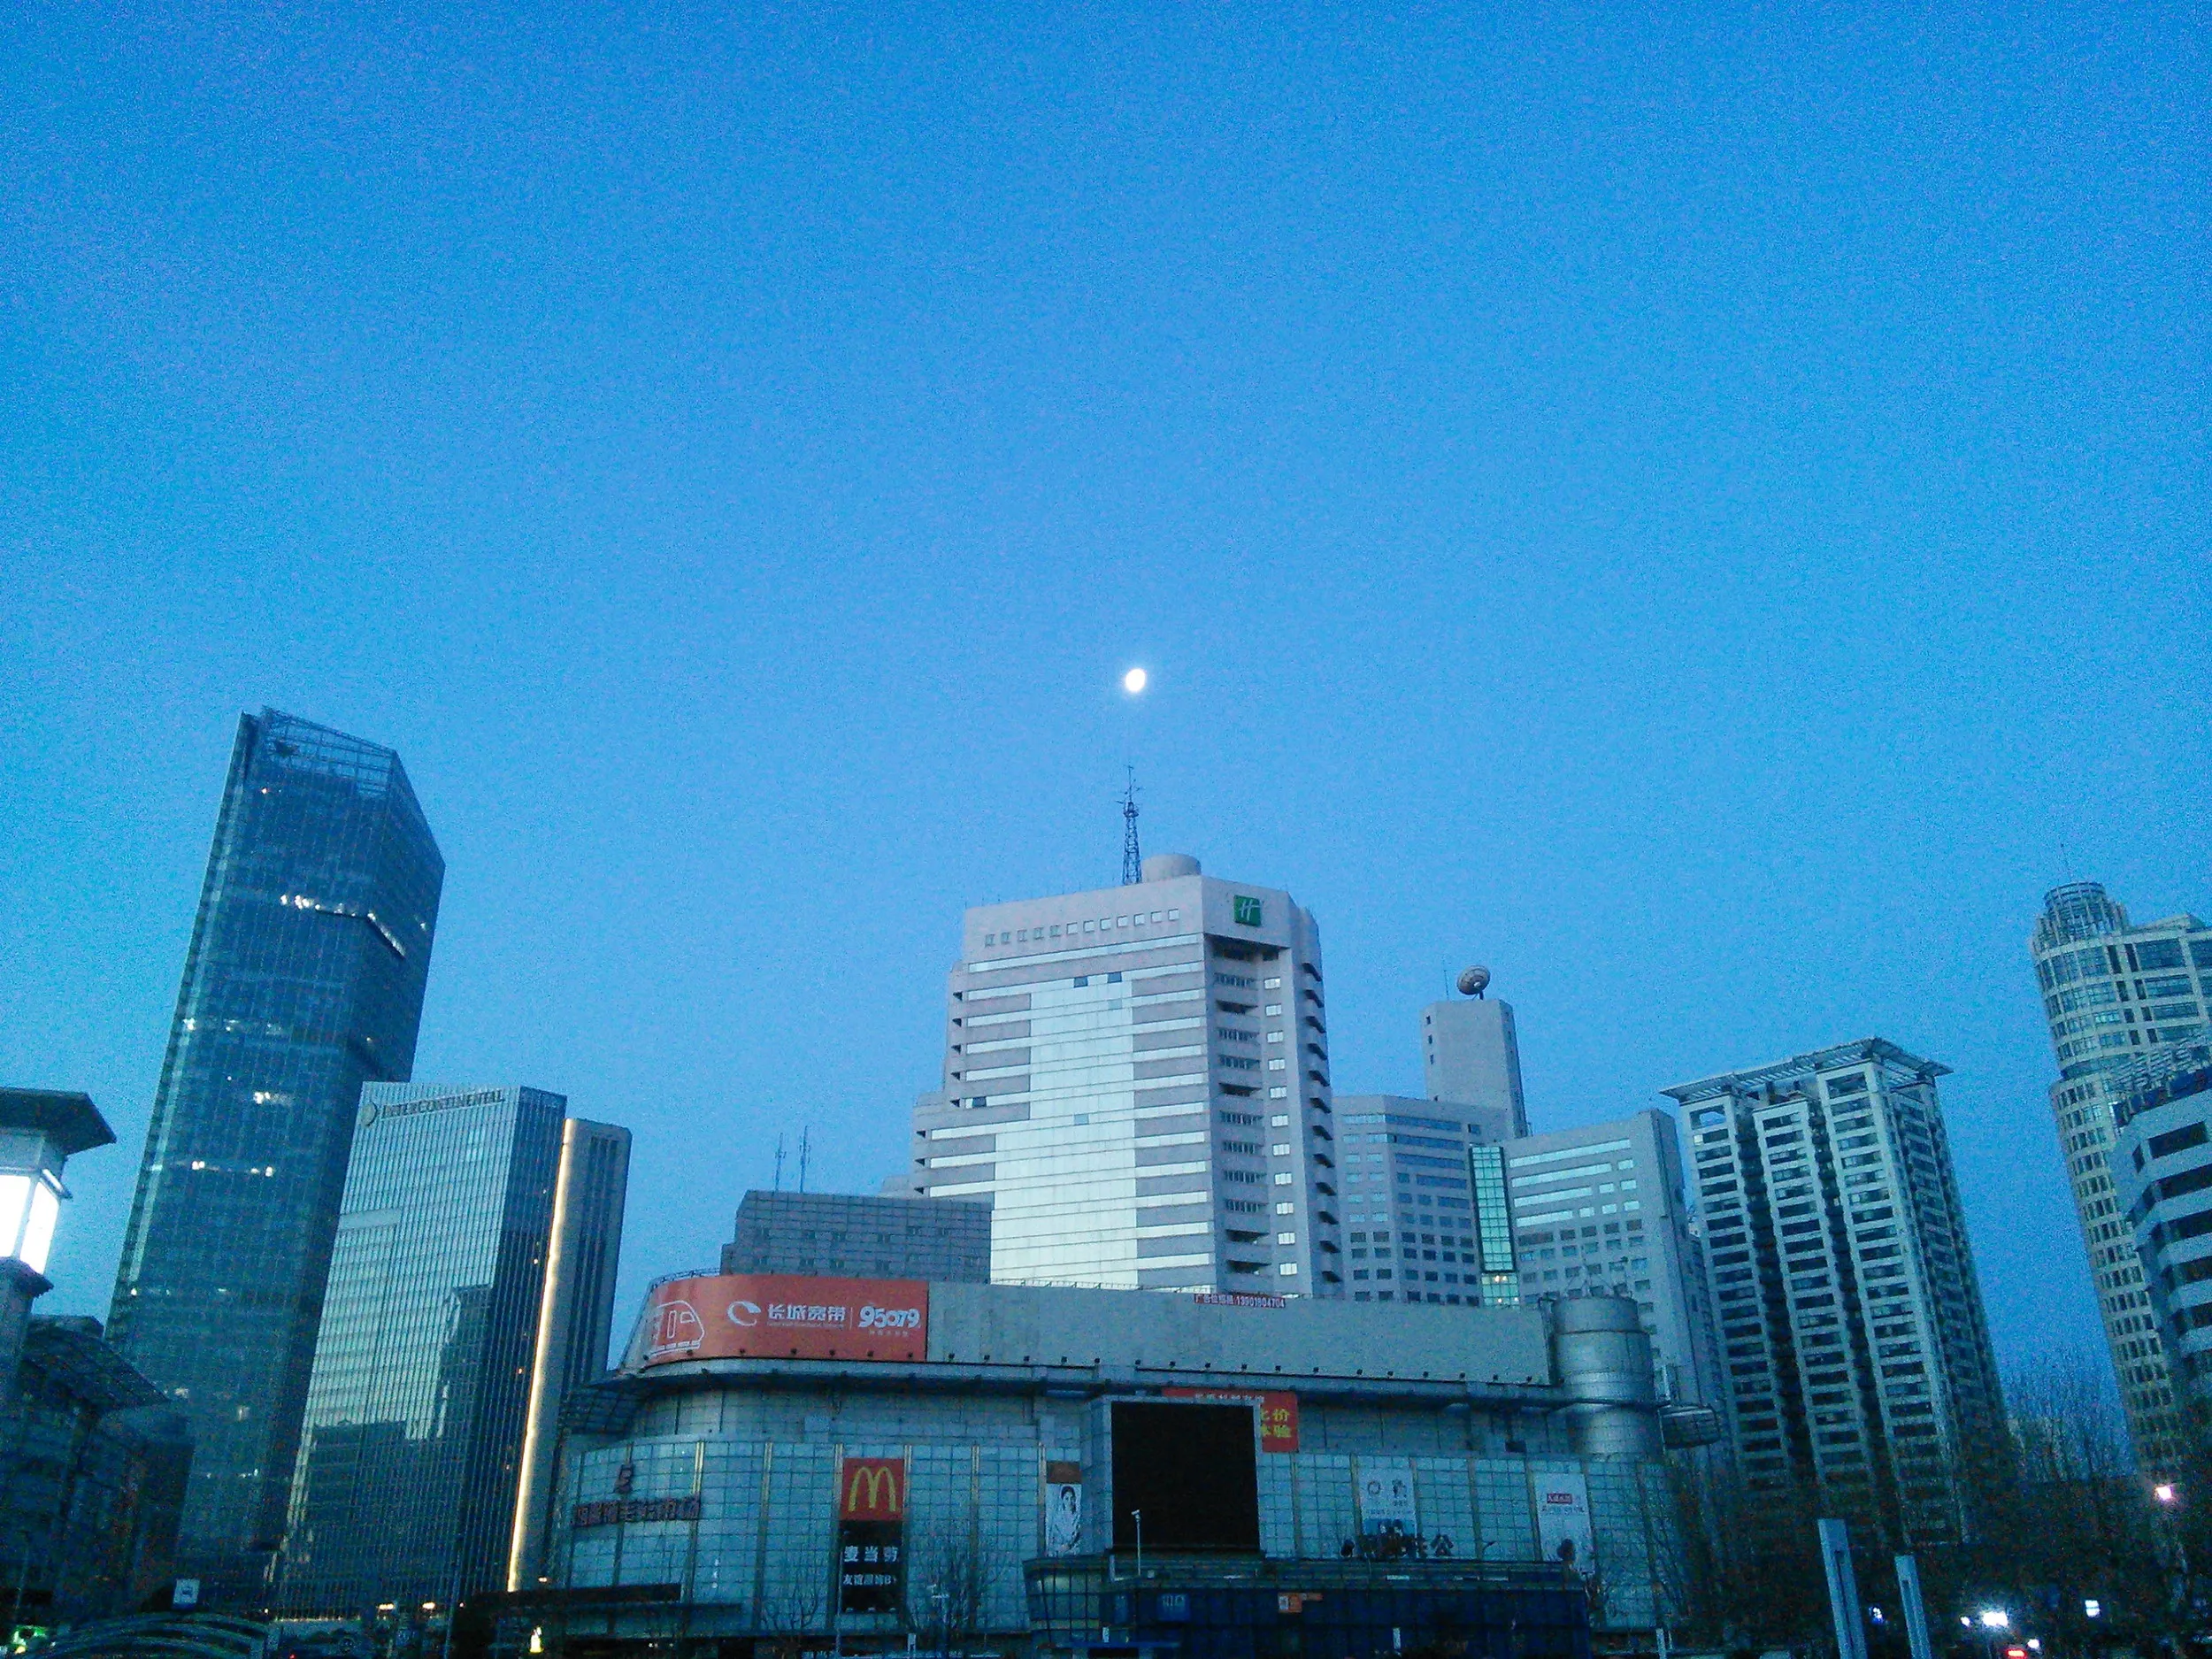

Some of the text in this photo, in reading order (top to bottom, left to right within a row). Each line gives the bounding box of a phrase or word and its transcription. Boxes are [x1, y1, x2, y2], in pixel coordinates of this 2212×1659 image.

[767, 1303, 920, 1328] 长城宽带 95079
[843, 1546, 898, 1562] 麦当劳
